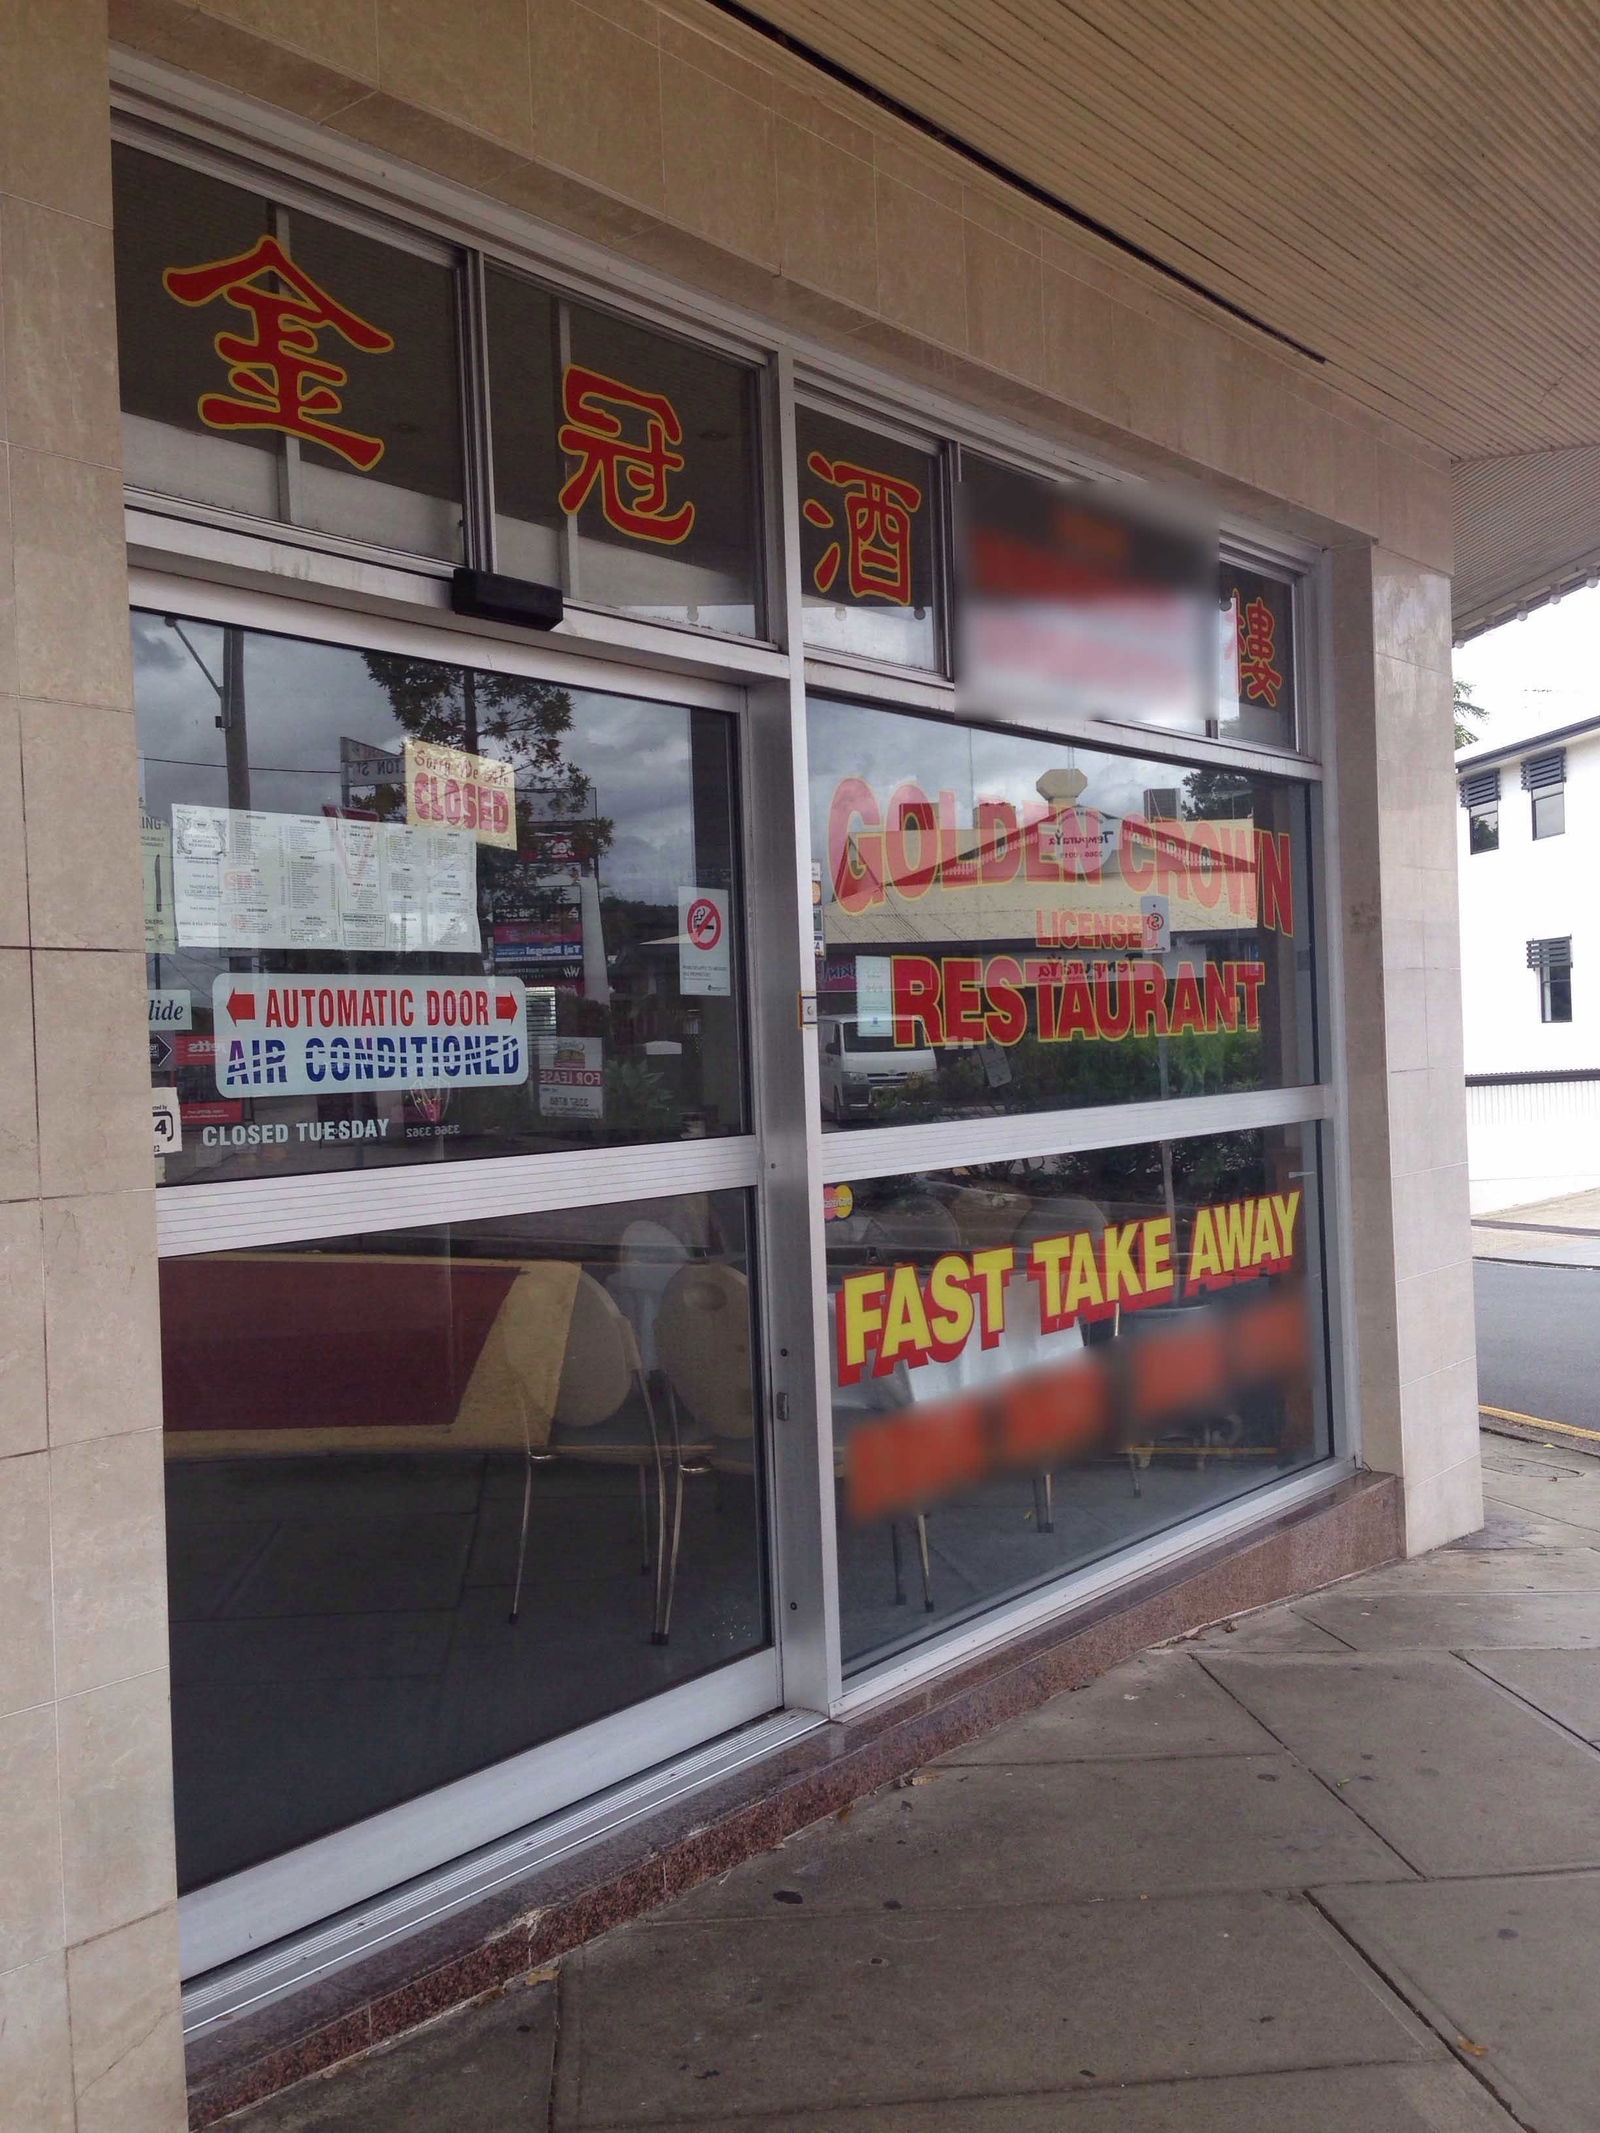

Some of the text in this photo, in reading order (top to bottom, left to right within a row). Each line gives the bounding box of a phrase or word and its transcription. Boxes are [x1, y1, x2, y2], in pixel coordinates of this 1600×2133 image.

[162, 234, 395, 471] 金
[557, 362, 696, 545] 冠
[803, 450, 923, 606] 酒
[414, 772, 510, 834] CLOSED
[827, 775, 1295, 938] GOLDEN CROWN
[1035, 909, 1159, 950] LICENSED
[265, 989, 491, 1029] AUTOMATIC DOOR
[891, 954, 1266, 1048] RESTAURANT
[226, 1035, 520, 1086] AIR CONDITIONED
[202, 1118, 390, 1147] CLOSED TUESDAY
[838, 1190, 1302, 1386] FAST TAKE AWAY
